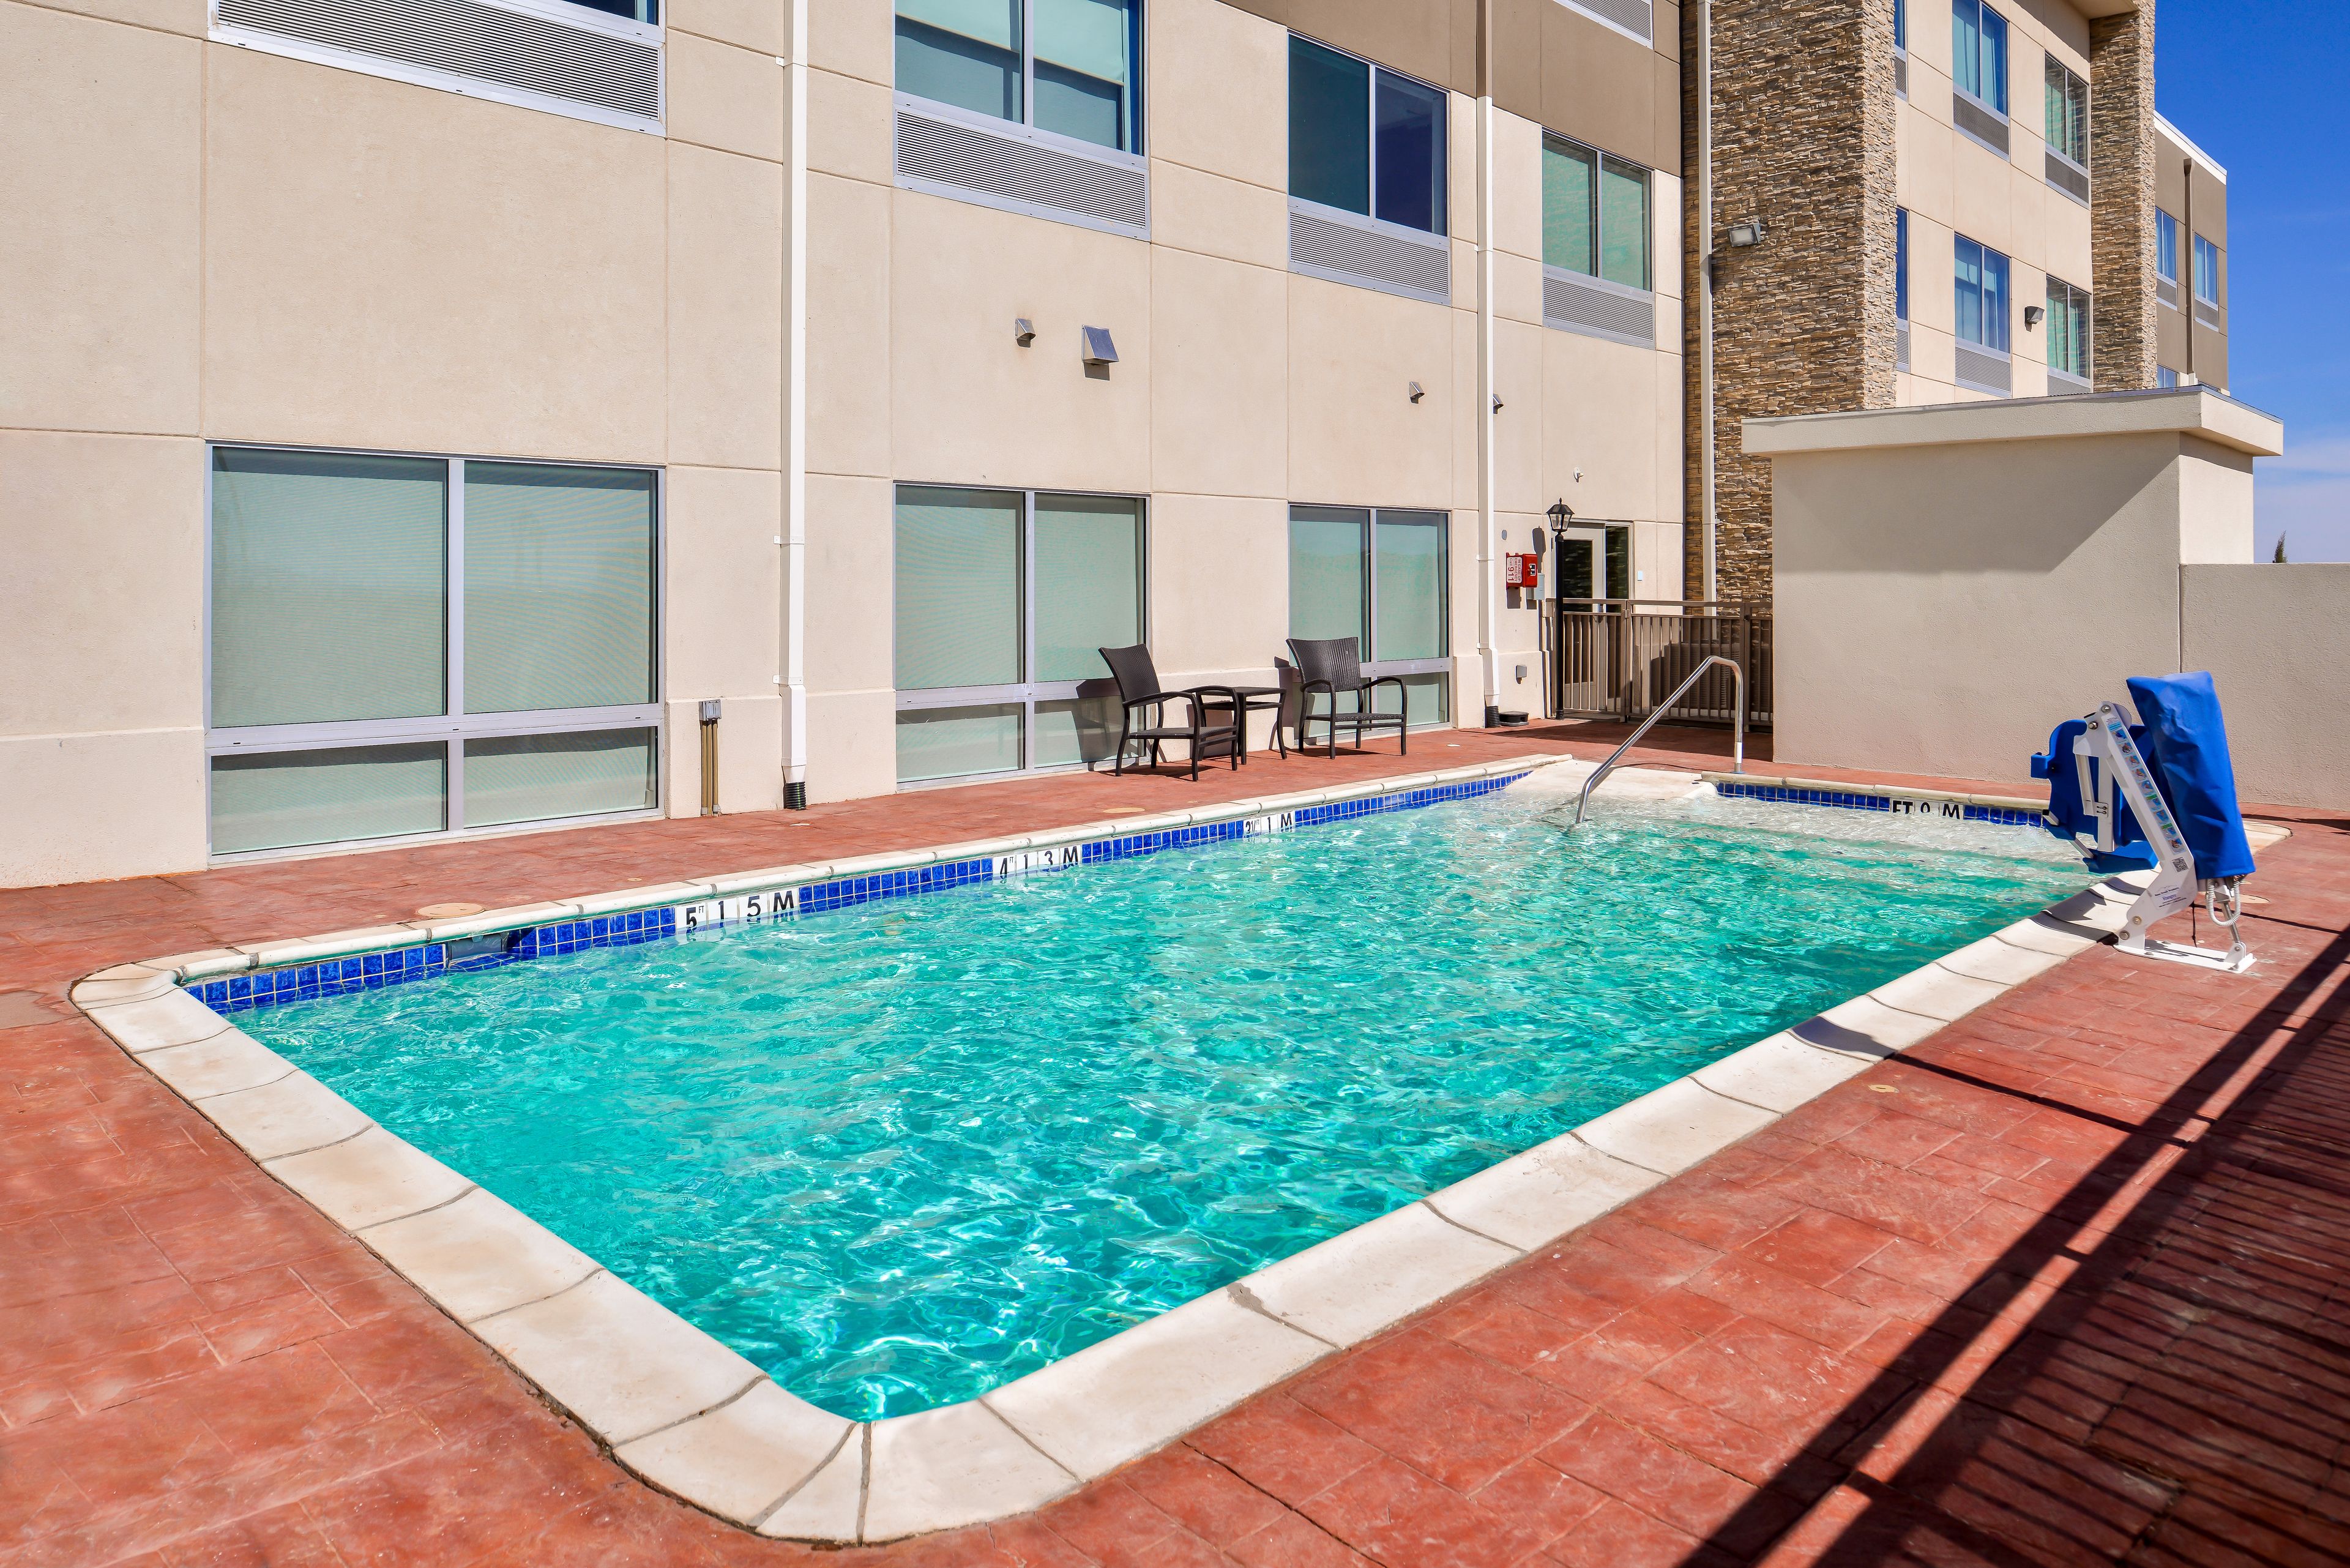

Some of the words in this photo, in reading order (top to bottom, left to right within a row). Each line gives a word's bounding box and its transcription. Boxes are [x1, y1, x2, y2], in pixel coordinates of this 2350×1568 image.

[1892, 800, 1913, 814] FT
[1942, 804, 1960, 819] M
[1281, 813, 1292, 831] M
[1000, 857, 1009, 876] 4
[1063, 846, 1078, 868] M
[686, 907, 698, 928] 5
[698, 905, 704, 914] FT
[718, 900, 725, 923] 1
[747, 895, 761, 917] 5
[773, 890, 794, 915] M
